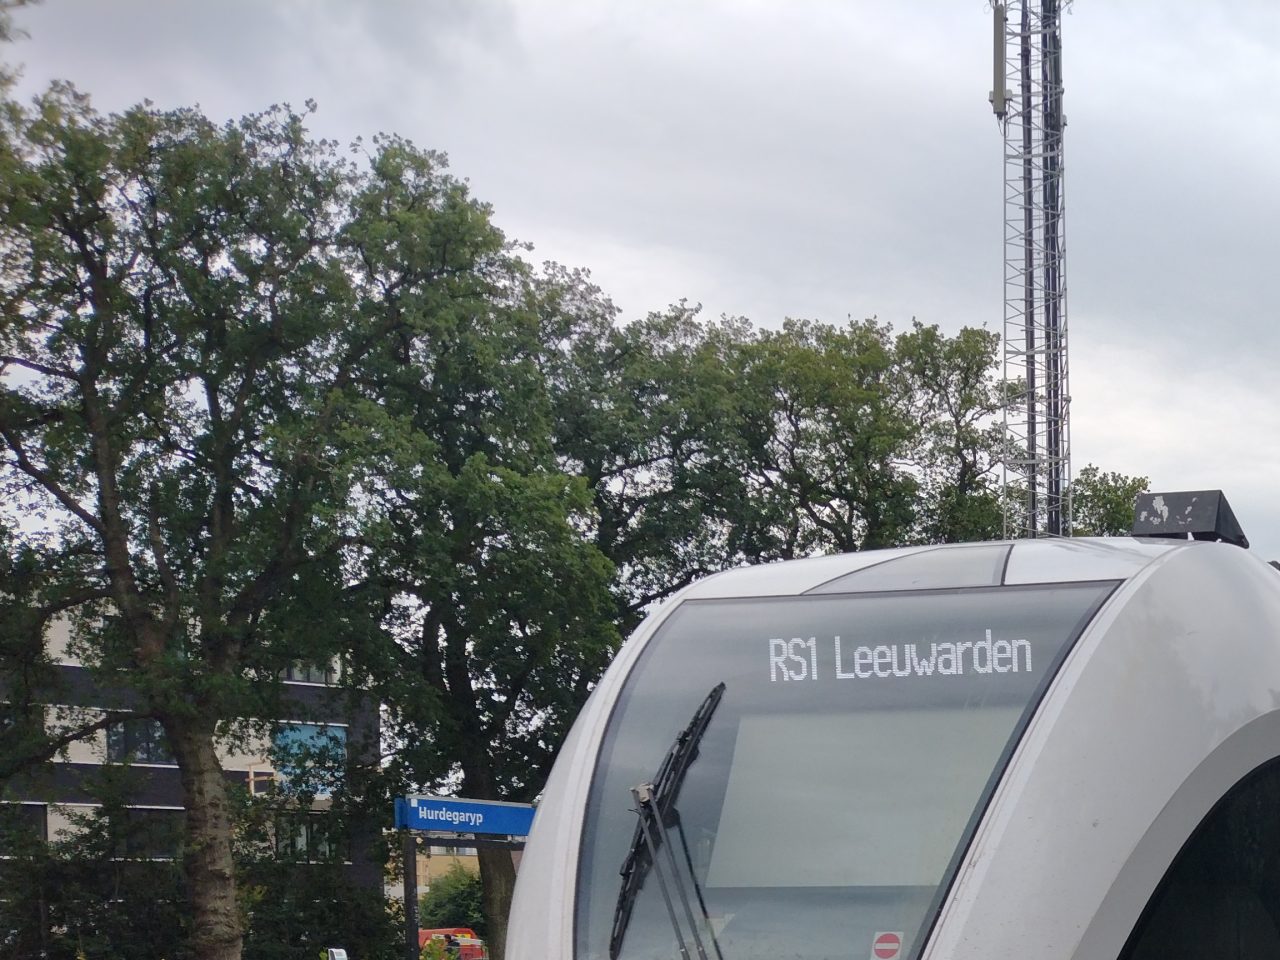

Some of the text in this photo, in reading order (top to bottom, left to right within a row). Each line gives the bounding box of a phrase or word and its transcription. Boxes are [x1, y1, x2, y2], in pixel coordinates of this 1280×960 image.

[768, 629, 1032, 682] RS1 Leeuwarden
[418, 806, 484, 826] Hurdegaryp
